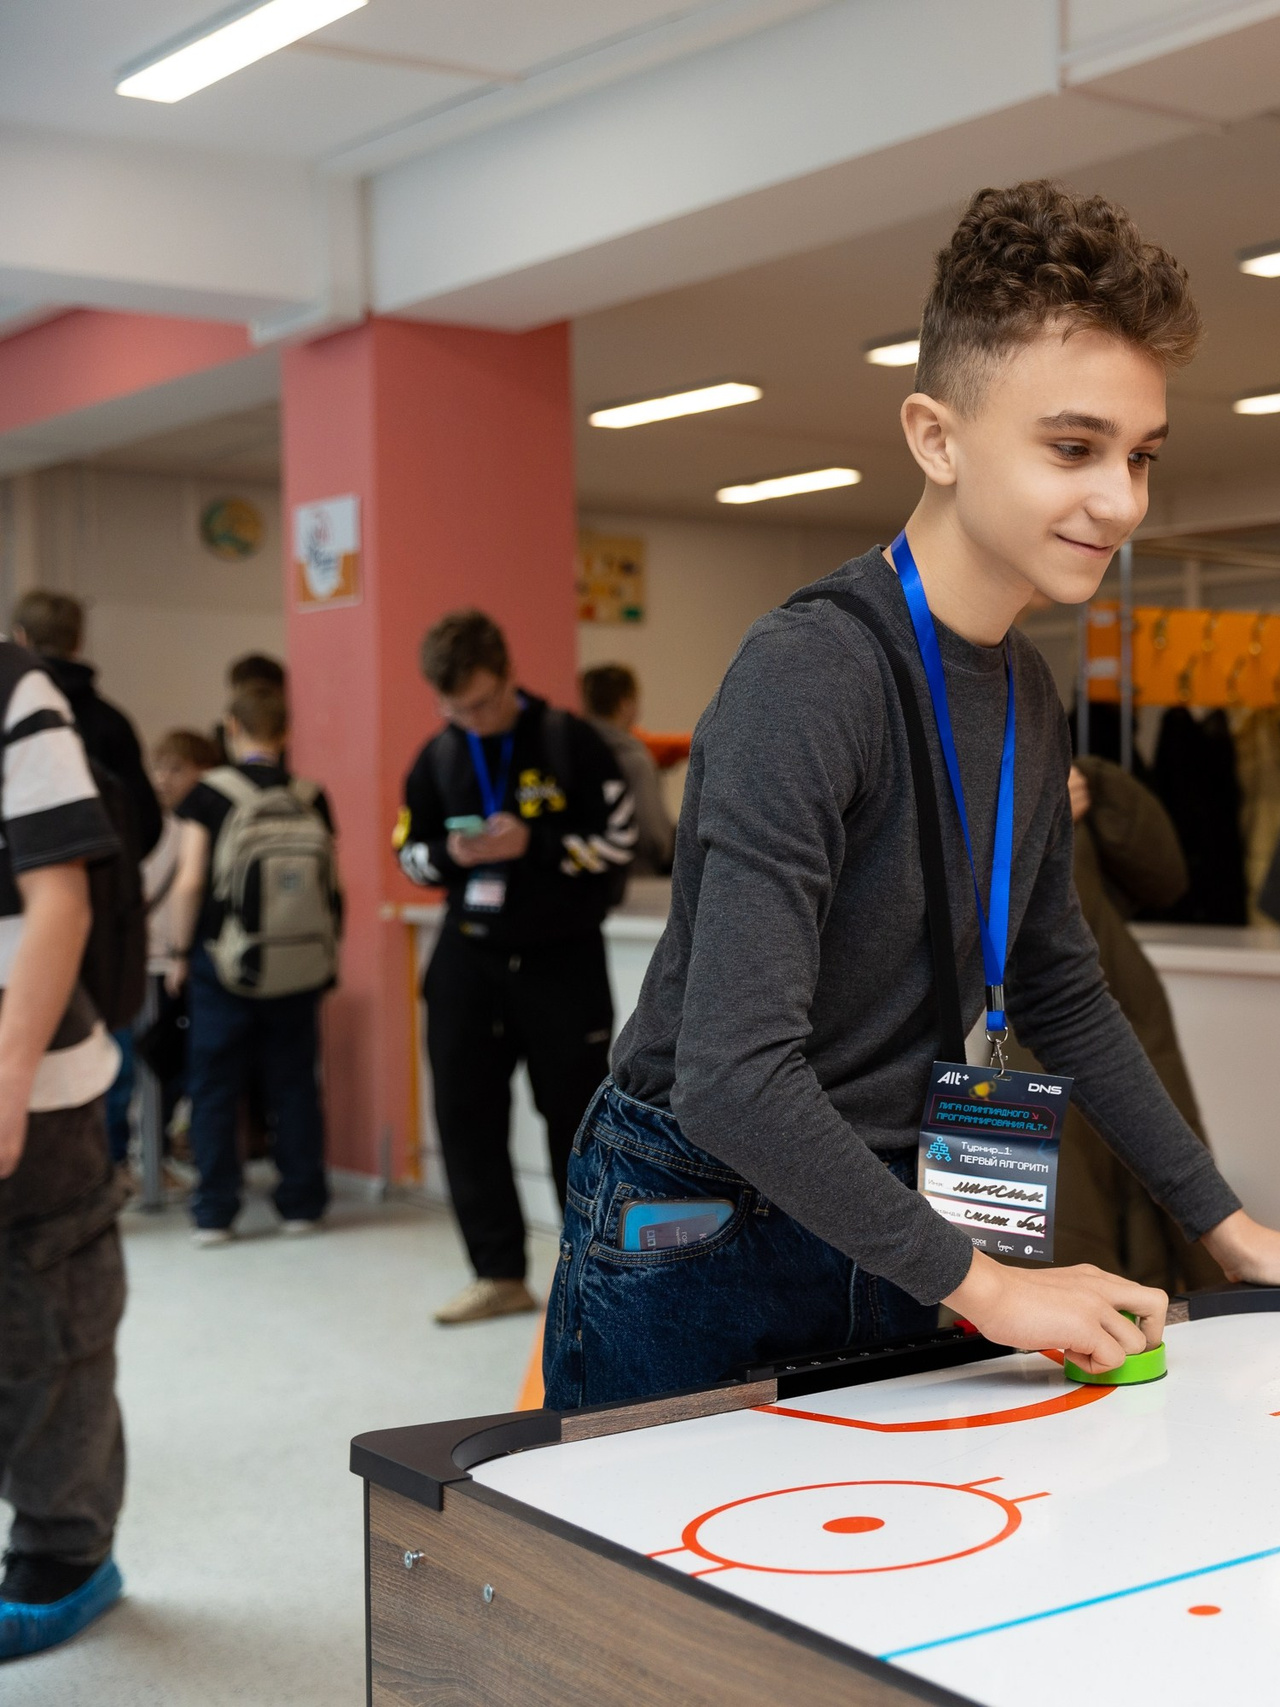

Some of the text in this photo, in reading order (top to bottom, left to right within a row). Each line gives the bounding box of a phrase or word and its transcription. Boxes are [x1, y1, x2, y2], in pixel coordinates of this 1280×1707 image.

[937, 1071, 1063, 1095] Alt+ DNS
[959, 1154, 1049, 1173] ПЕРВЫЙ АЛГОРИТМ
